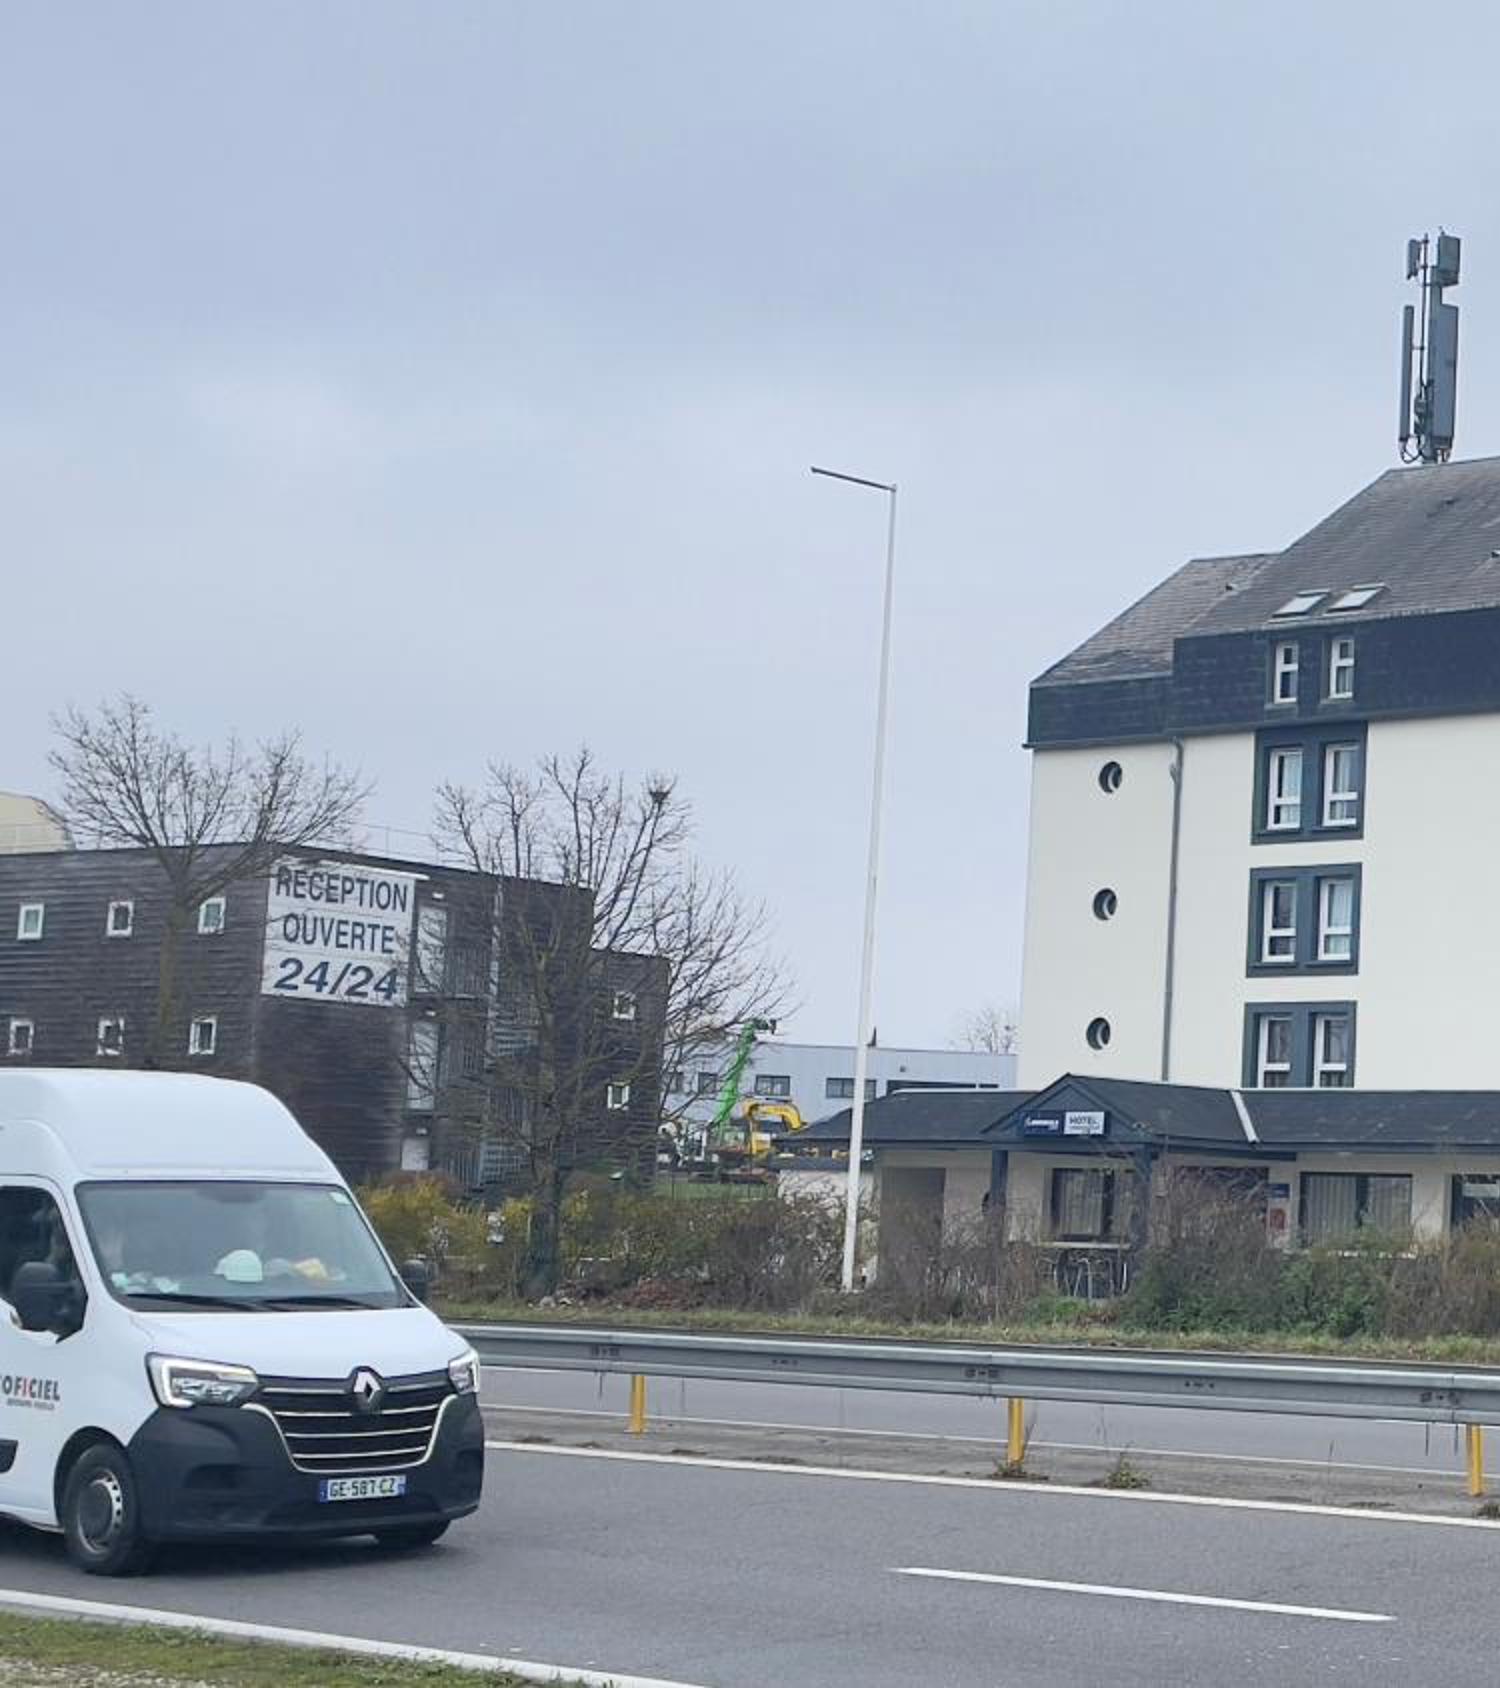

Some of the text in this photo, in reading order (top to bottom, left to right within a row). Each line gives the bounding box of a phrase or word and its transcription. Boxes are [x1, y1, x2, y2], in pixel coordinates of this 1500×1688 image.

[283, 913, 395, 953] OUVERTE
[273, 958, 398, 1000] 24/24
[0, 1375, 61, 1401] OFICIEL
